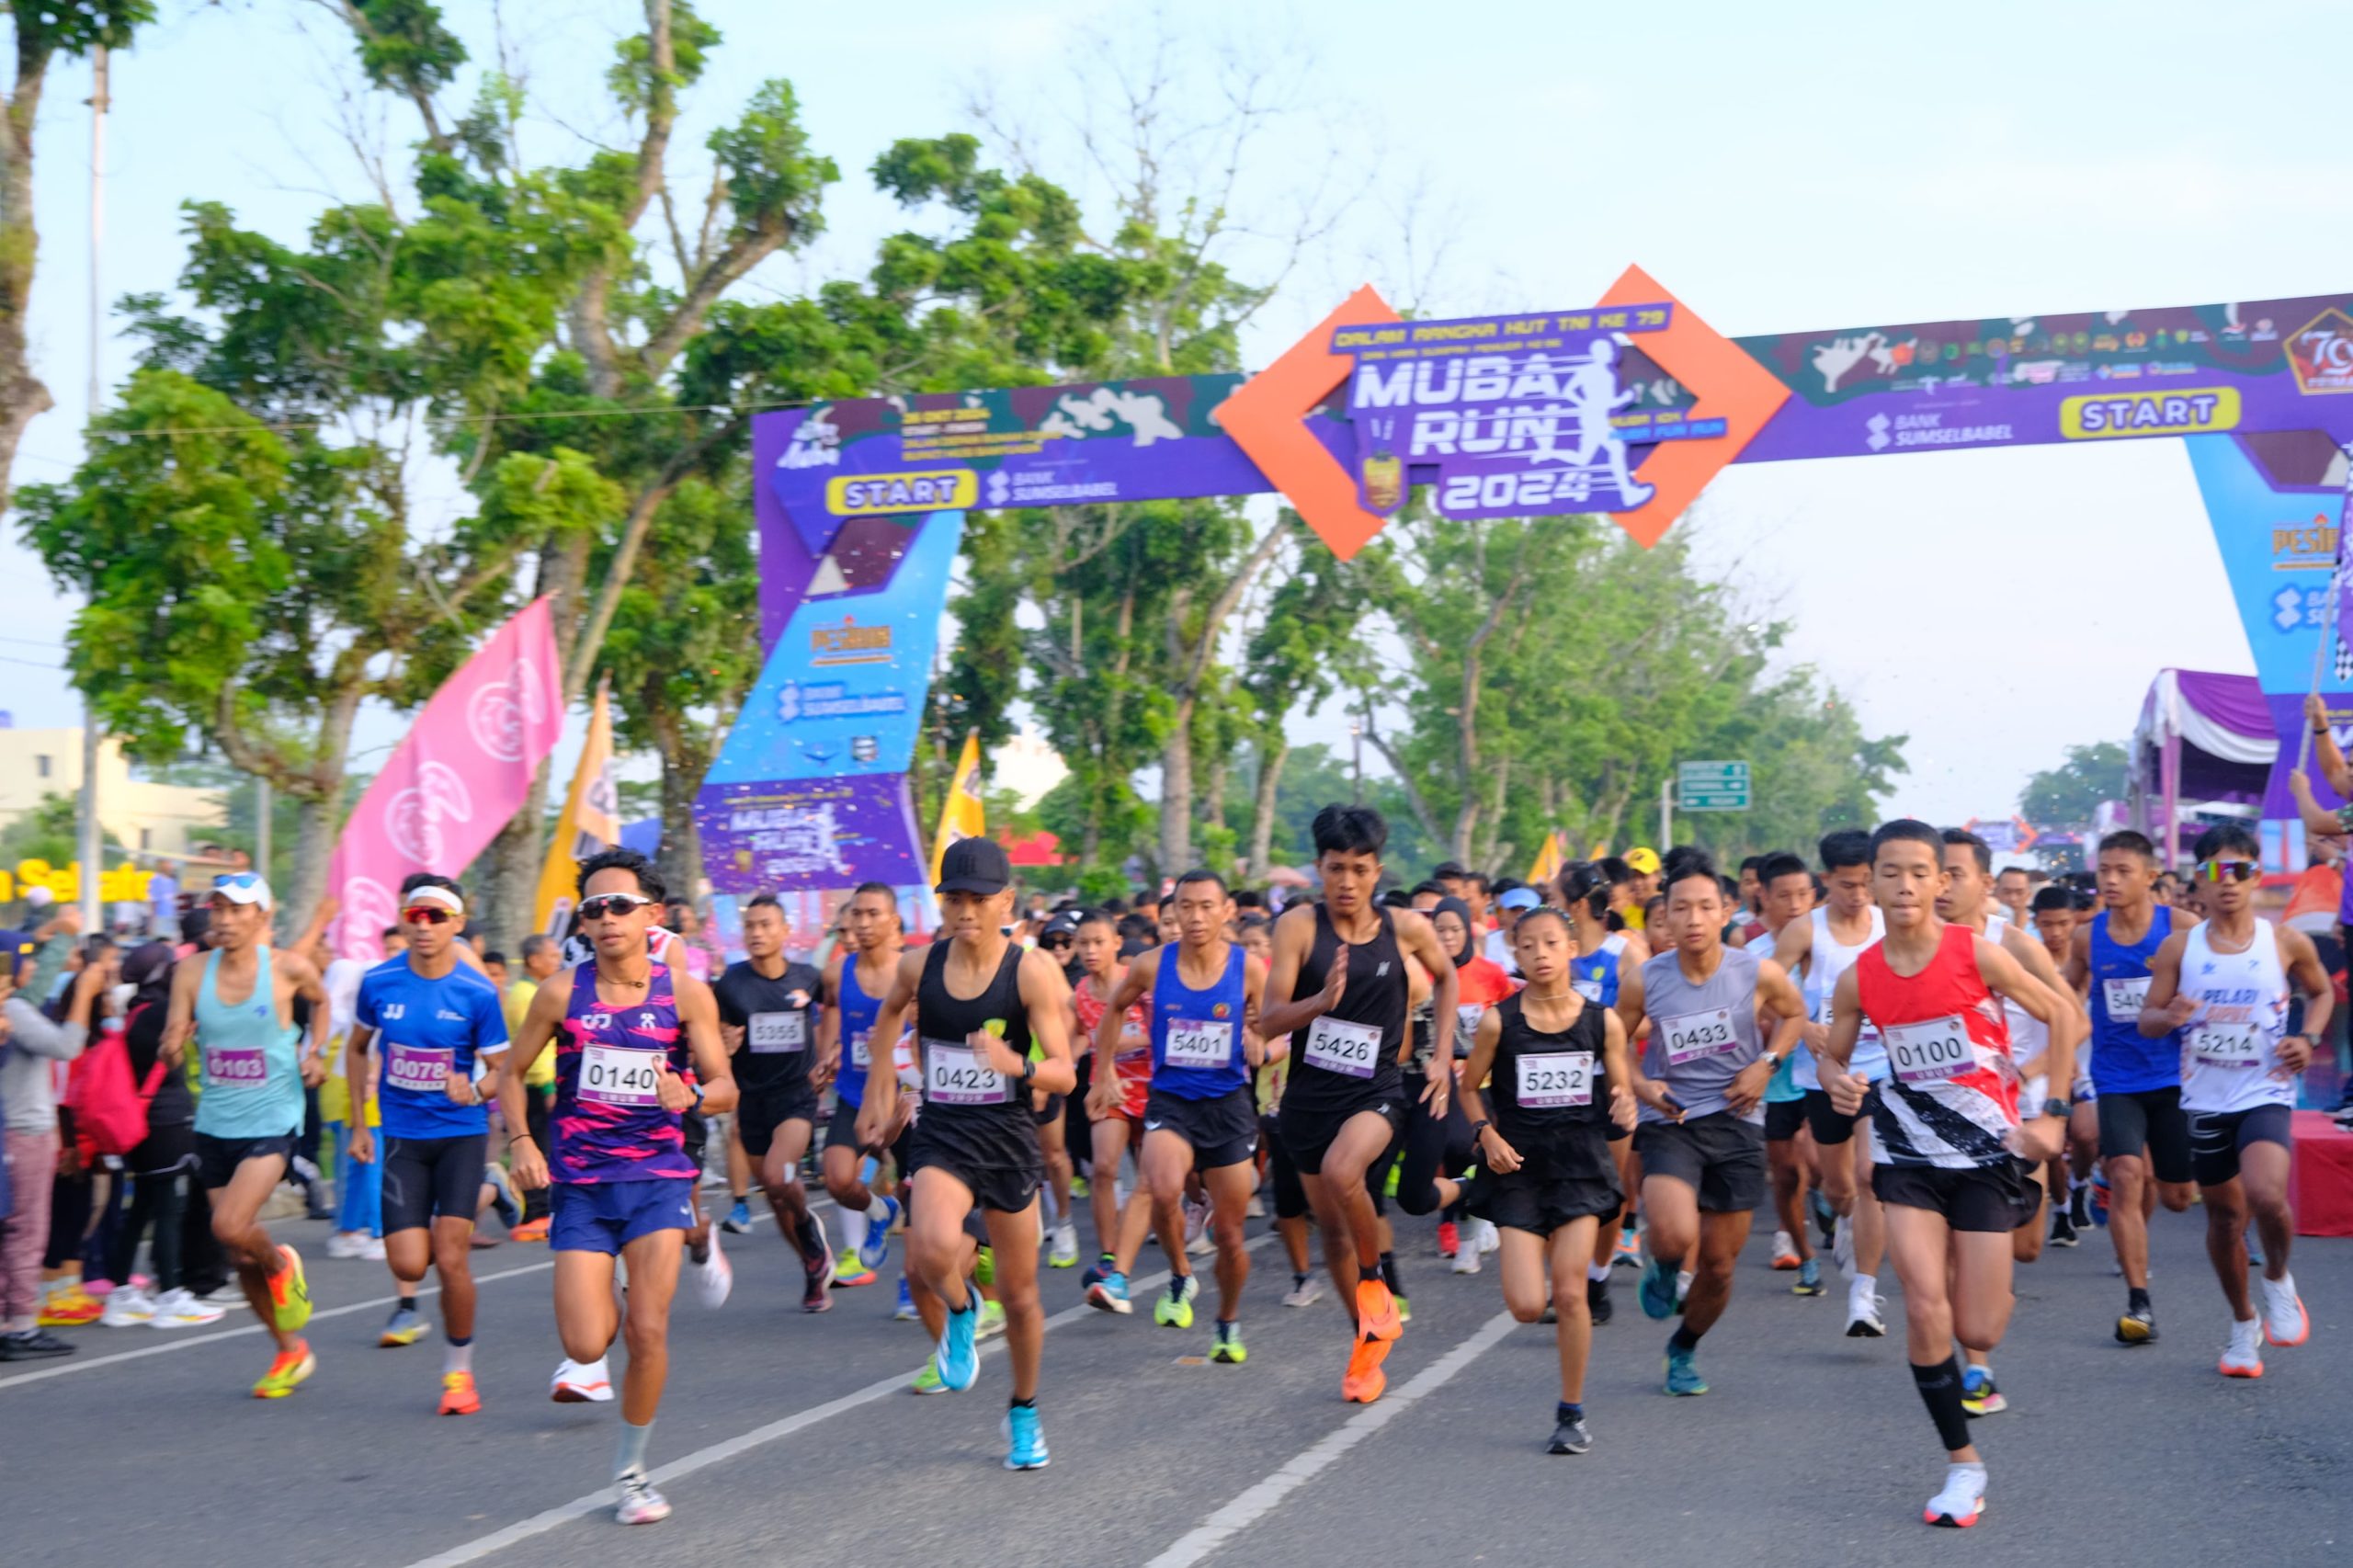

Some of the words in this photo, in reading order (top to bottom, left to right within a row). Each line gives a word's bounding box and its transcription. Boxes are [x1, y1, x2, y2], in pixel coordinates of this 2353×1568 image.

[1505, 319, 1549, 335] HUT
[1558, 316, 1590, 331] TNI
[1598, 313, 1627, 328] KE
[1638, 311, 1665, 324] 79
[1353, 353, 1563, 408] MUBA
[1894, 415, 1941, 429] BANK
[2082, 396, 2217, 429] START
[1410, 405, 1561, 456] RUN
[846, 476, 957, 506] START
[1442, 472, 1591, 510] 2024
[1173, 1034, 1222, 1054] 5401
[1314, 1033, 1370, 1061] 5426
[1671, 1024, 1727, 1050] 0433
[2198, 1034, 2254, 1054] 5214
[1897, 1038, 1962, 1066] 0100
[392, 1057, 448, 1079] 0078
[589, 1064, 654, 1089] 0140
[936, 1066, 996, 1089] 0423
[1526, 1070, 1583, 1091] 5232
[1915, 1066, 1955, 1080] UMUM
